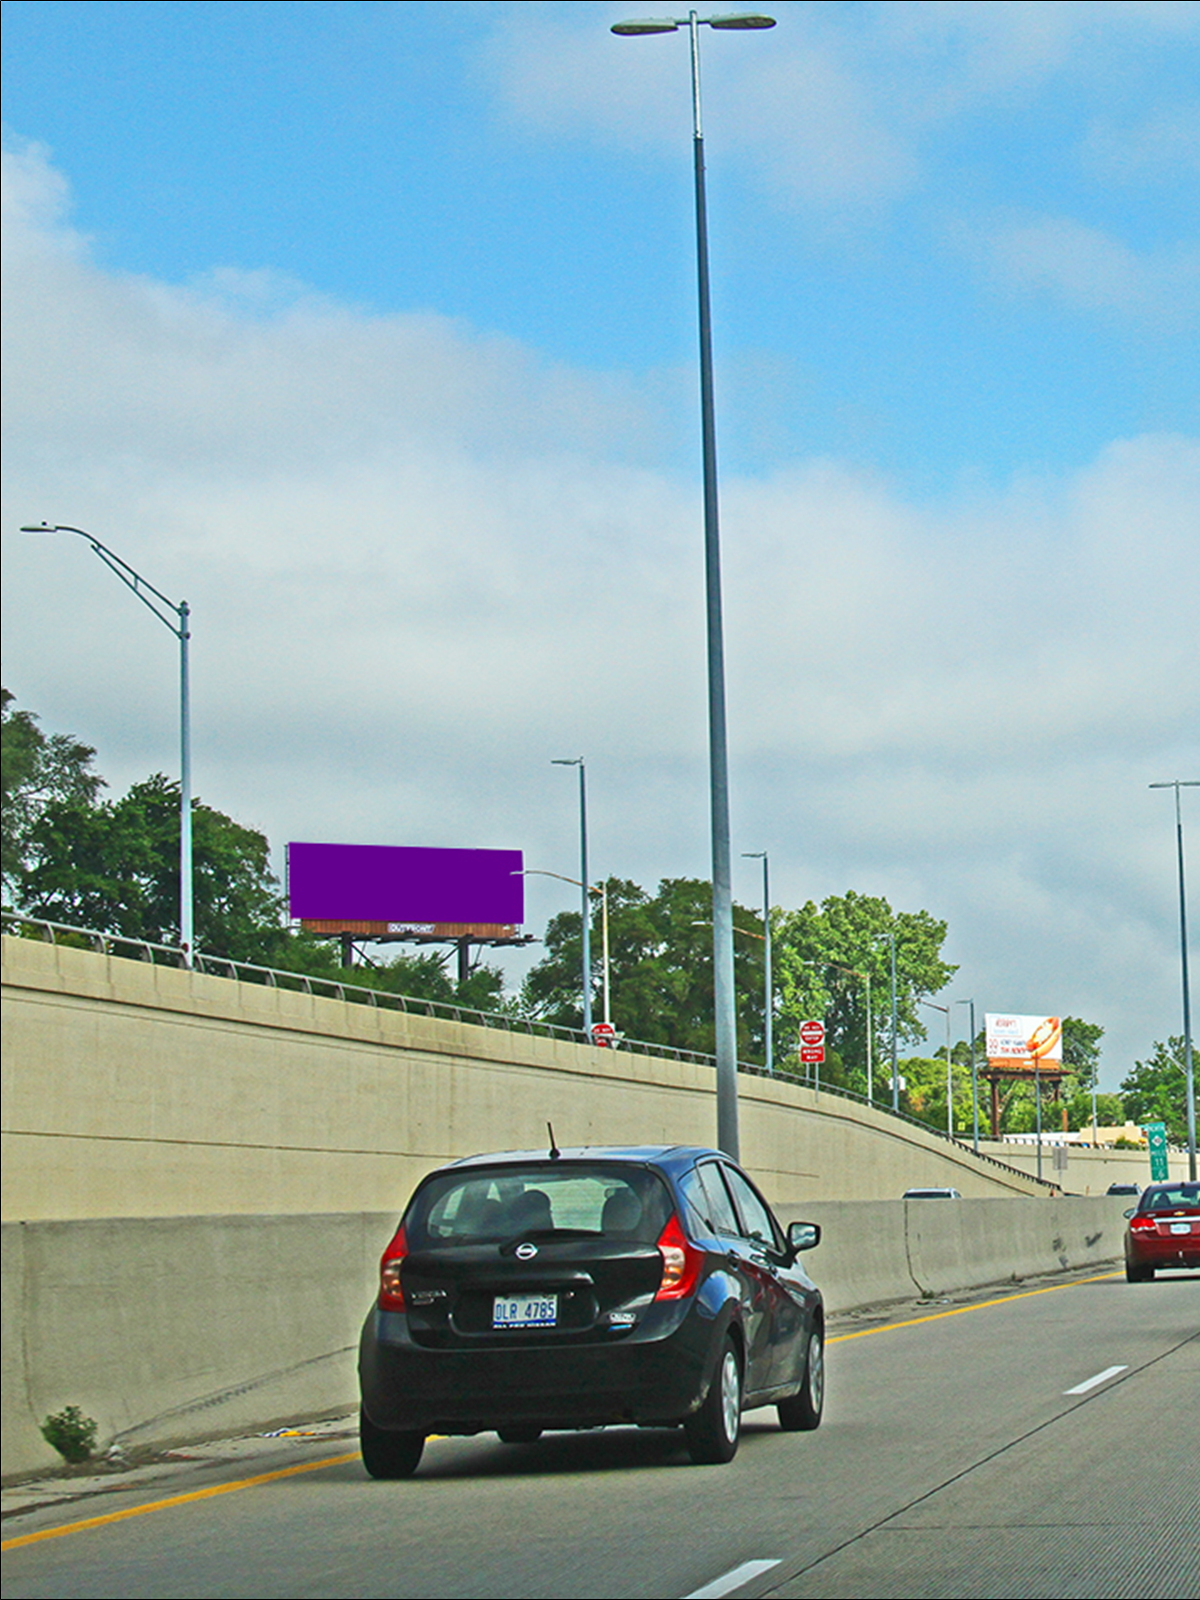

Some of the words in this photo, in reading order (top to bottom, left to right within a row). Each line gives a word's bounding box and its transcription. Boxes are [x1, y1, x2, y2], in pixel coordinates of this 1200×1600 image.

[1155, 1158, 1164, 1167] 11
[496, 1303, 518, 1320] DLR
[525, 1301, 555, 1318] 4785
